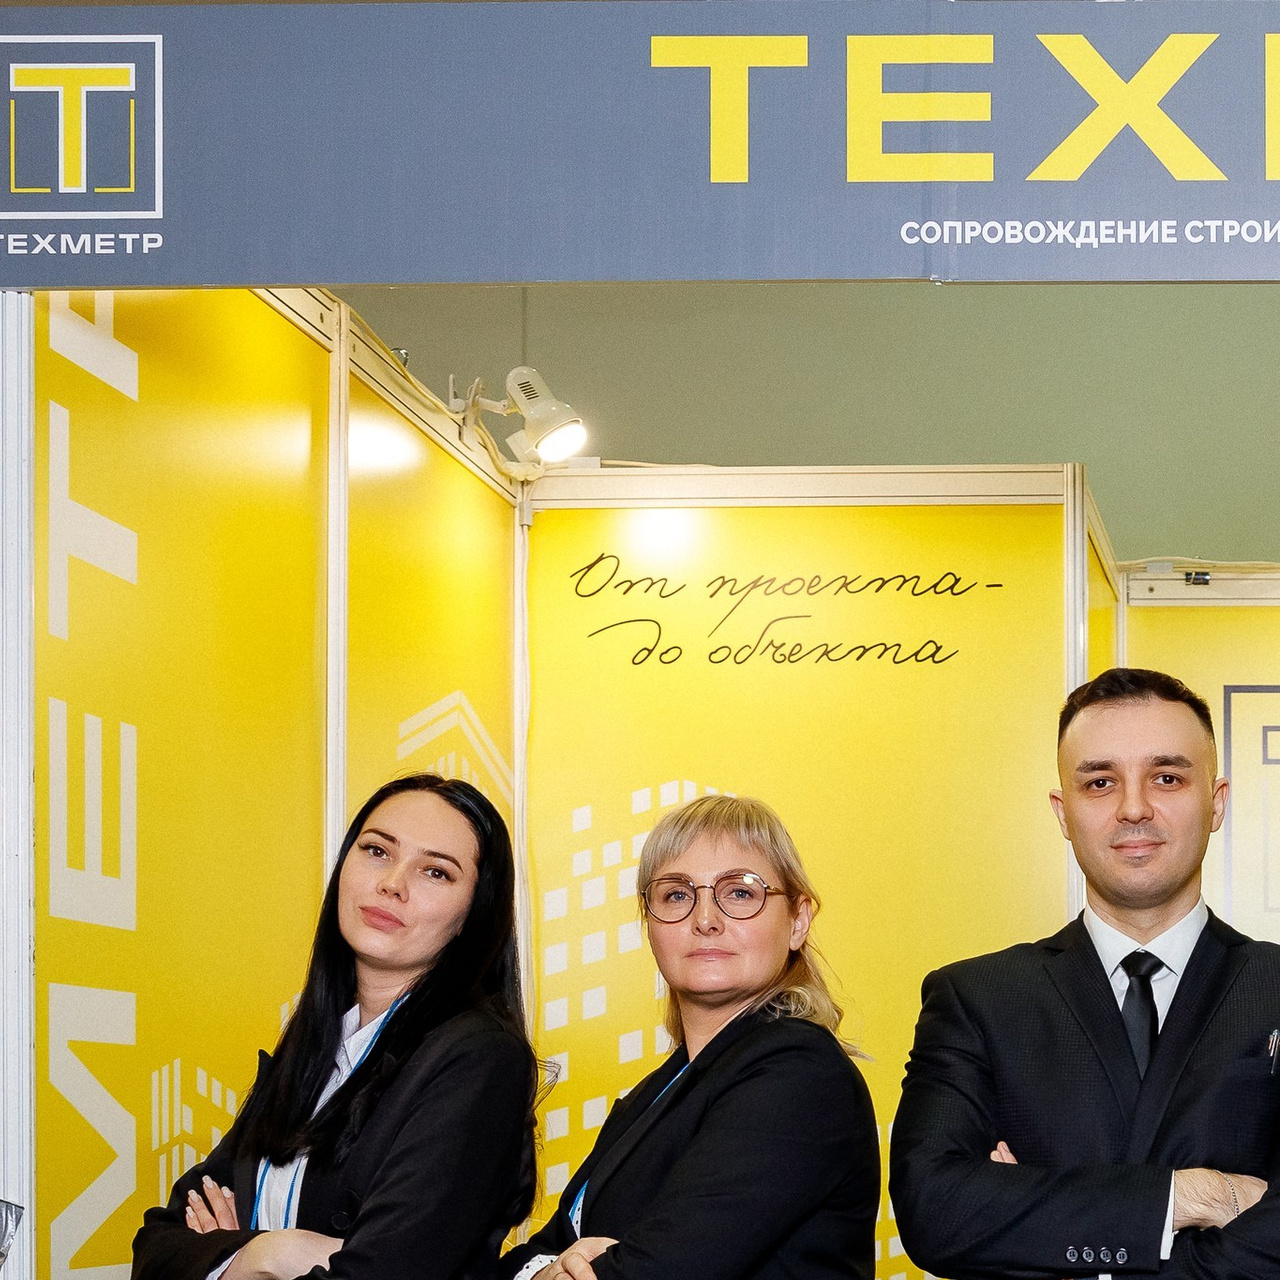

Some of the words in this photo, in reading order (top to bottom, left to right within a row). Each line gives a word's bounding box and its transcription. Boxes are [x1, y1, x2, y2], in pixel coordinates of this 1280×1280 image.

[0, 233, 164, 255] ЕХМЕТР
[900, 220, 1178, 248] СОПРОВОЖДЕНИЕ
[570, 552, 686, 598] От
[587, 618, 683, 666] до
[707, 615, 960, 666] объекта
